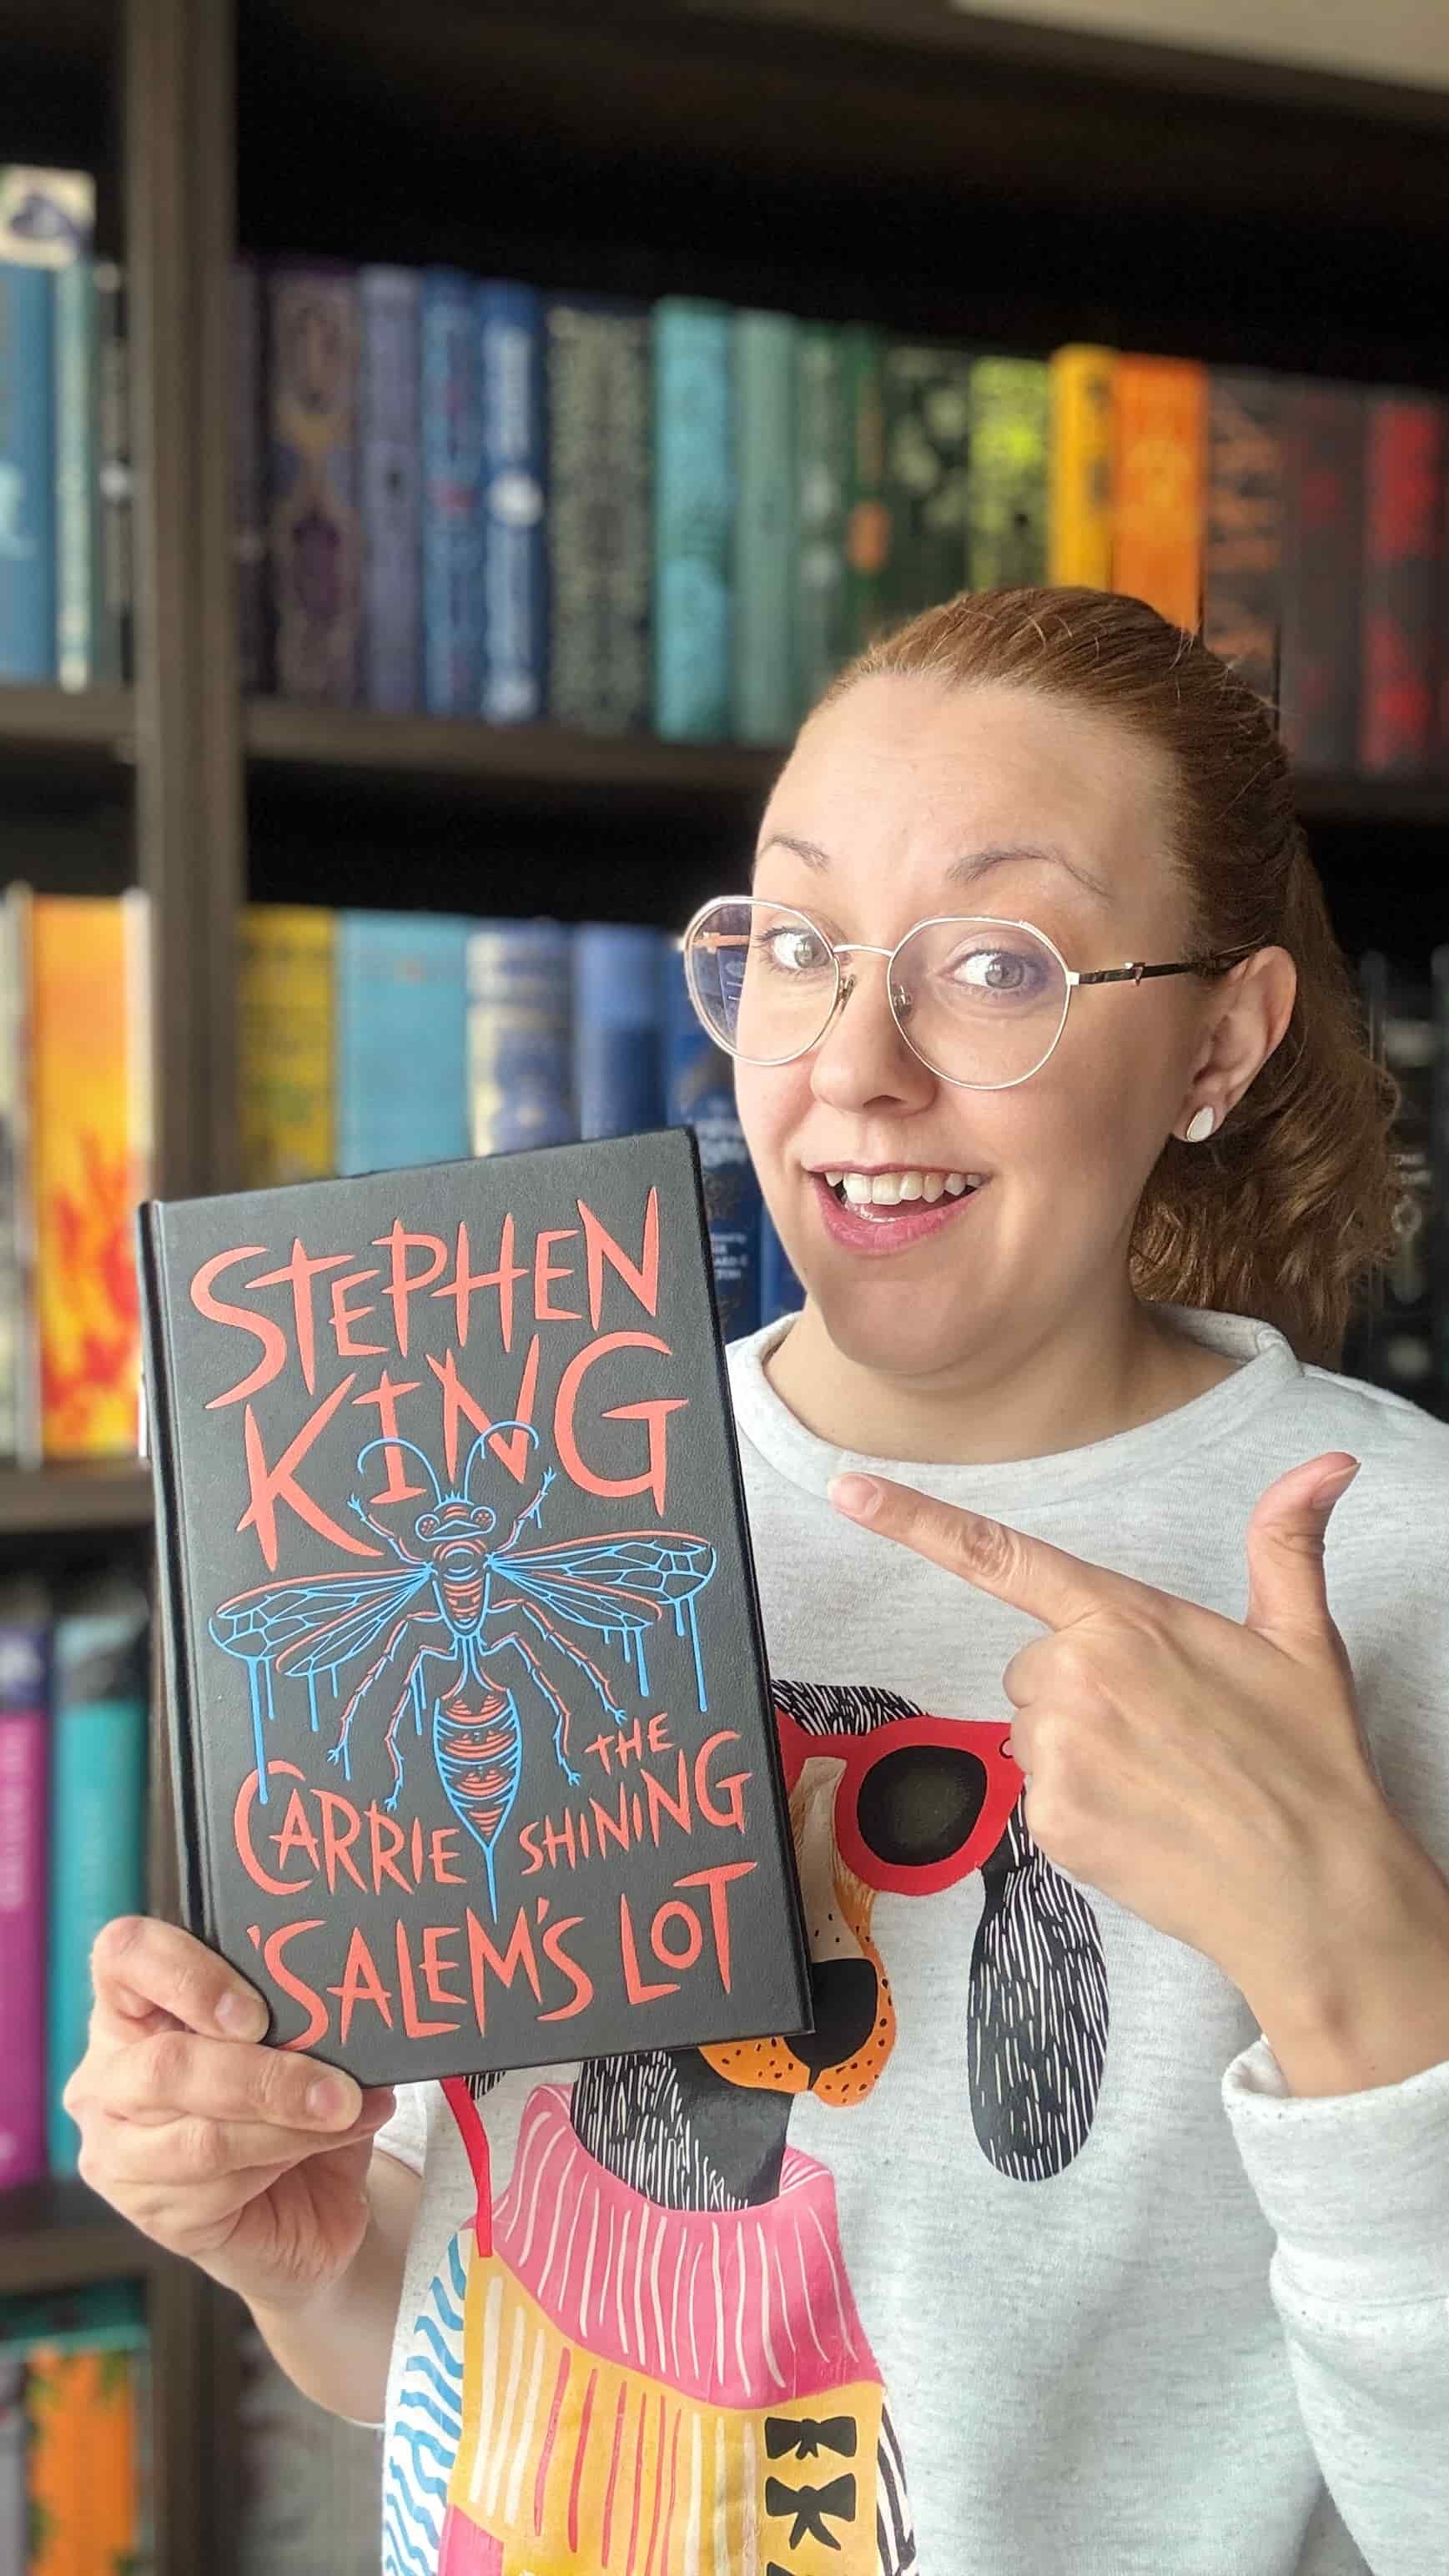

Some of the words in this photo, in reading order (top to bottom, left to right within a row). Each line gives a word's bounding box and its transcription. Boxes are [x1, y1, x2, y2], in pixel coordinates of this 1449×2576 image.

[190, 1186, 660, 1409] STEPHEN
[237, 1331, 689, 1572] KING
[519, 1730, 753, 1876] SHINING
[584, 1713, 672, 1774] THE
[234, 1759, 467, 1896] CARRIE
[621, 1861, 758, 2006] LOT
